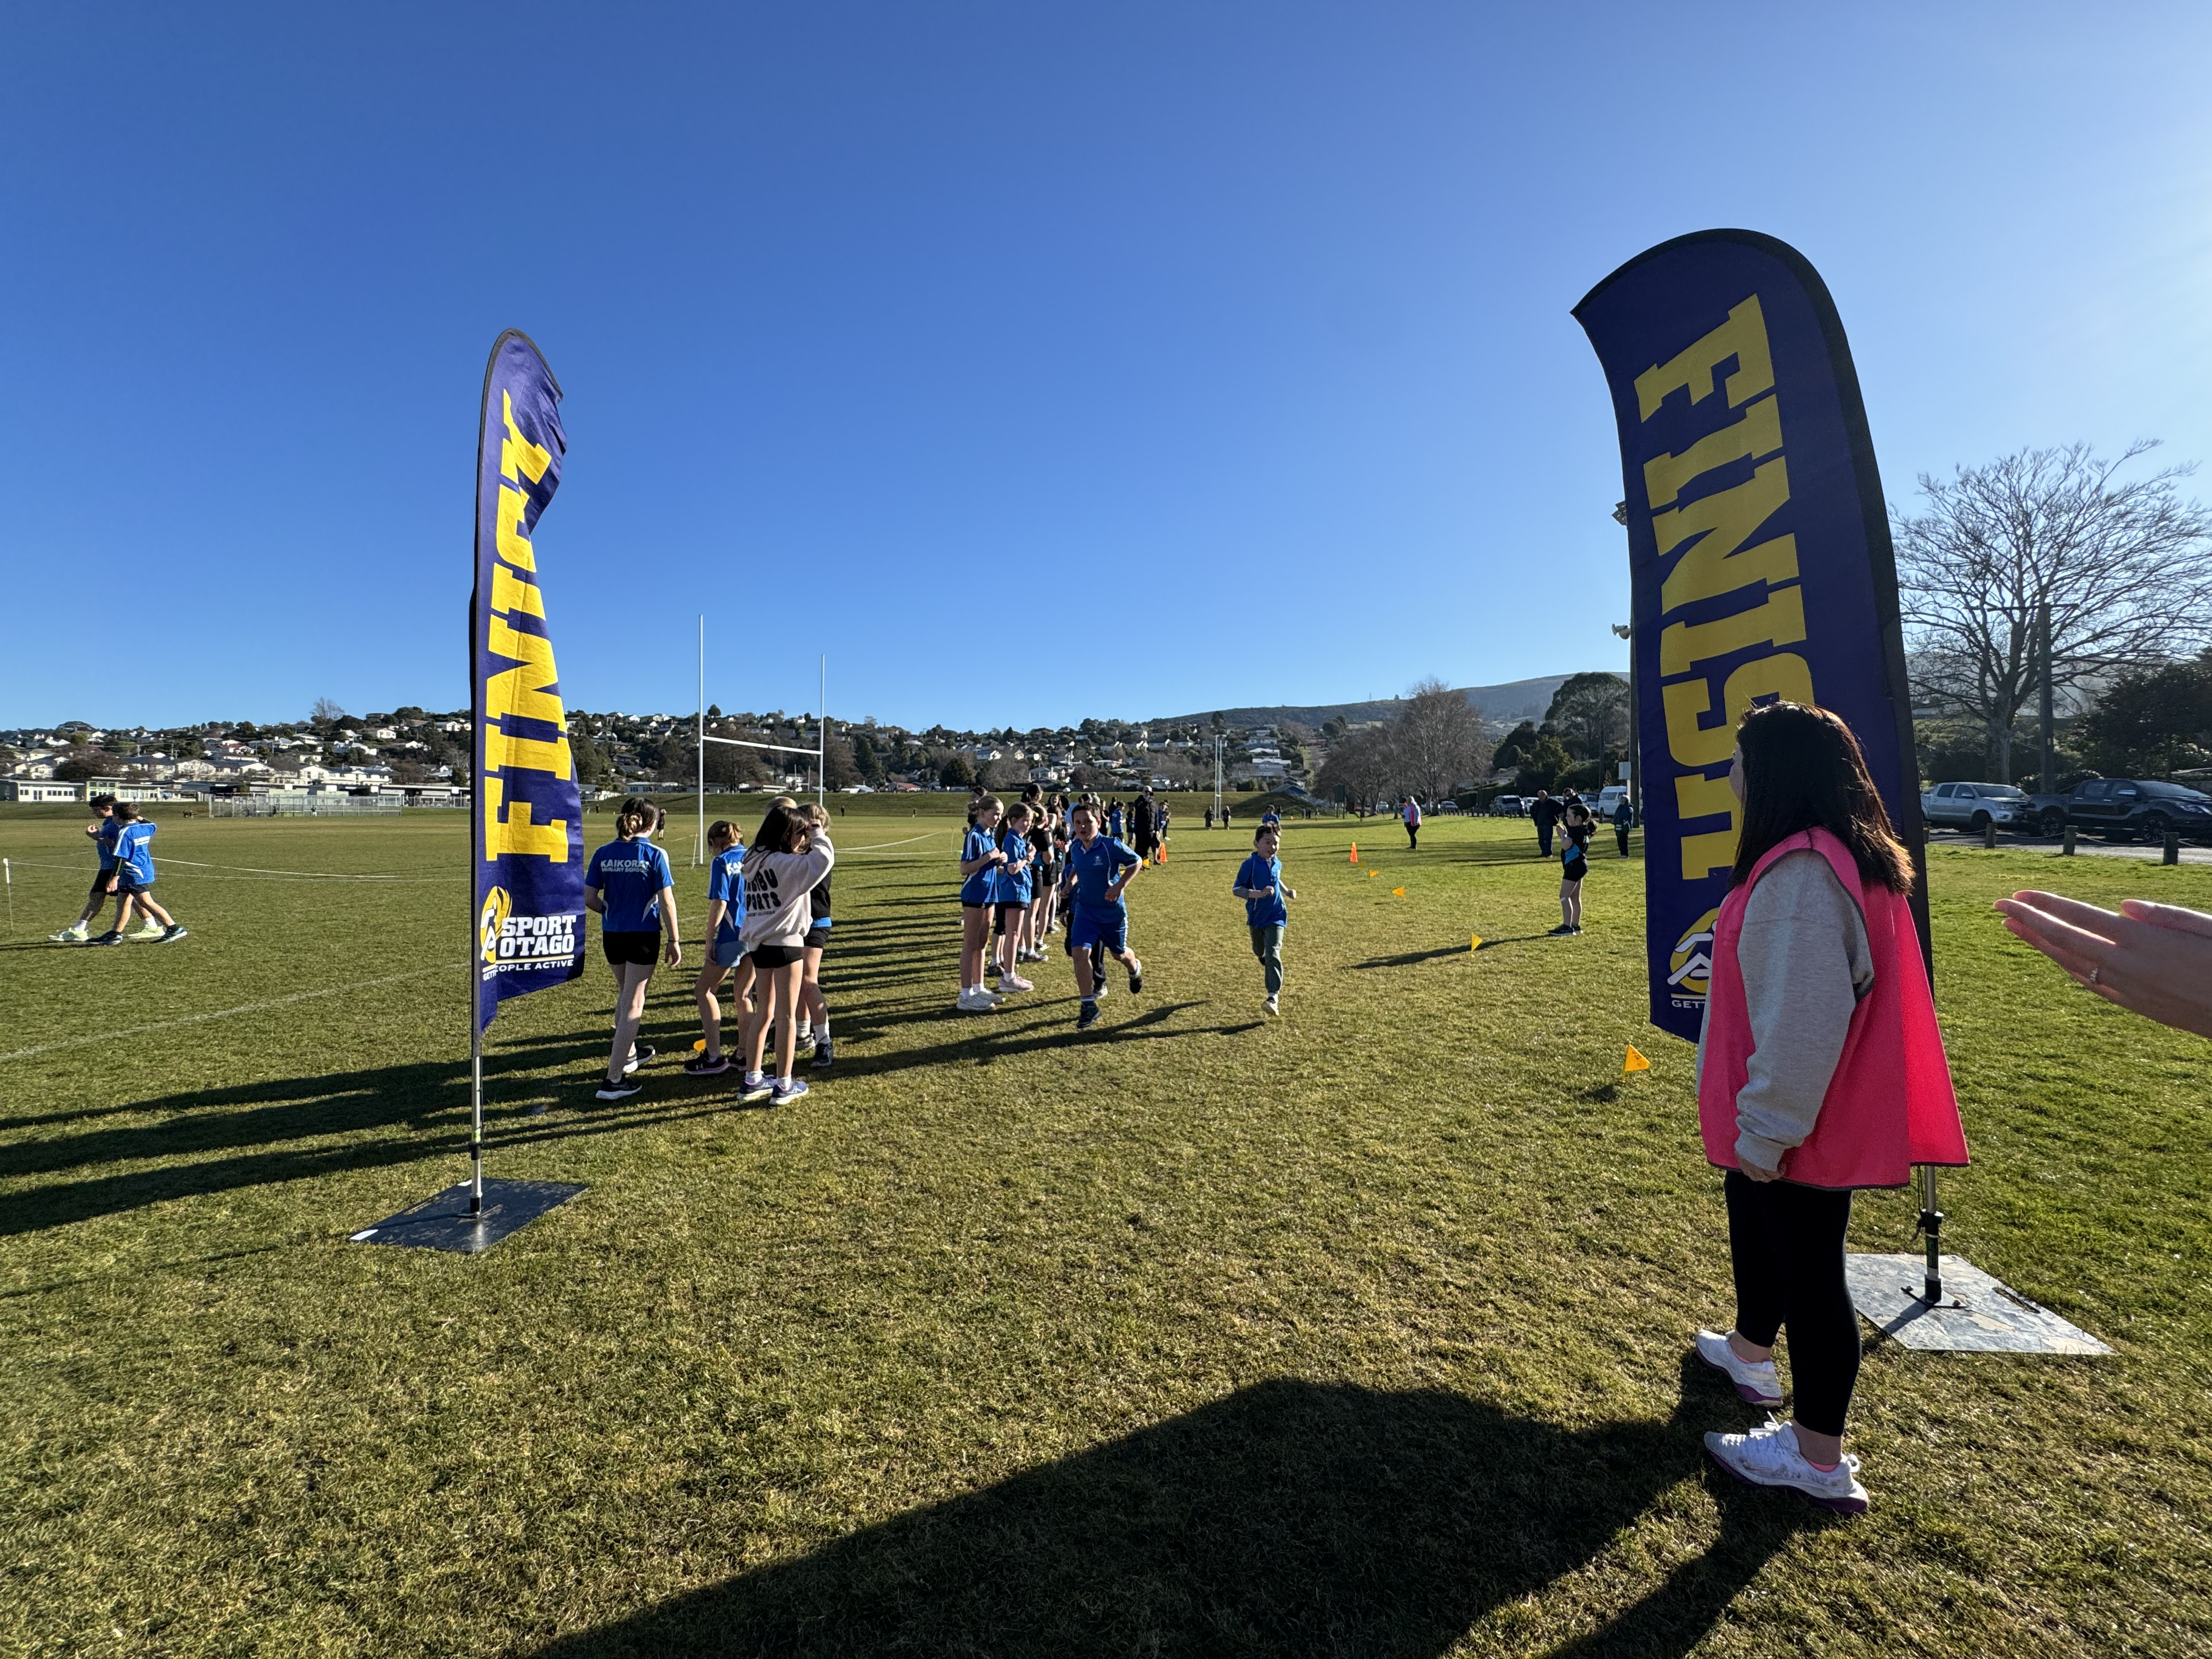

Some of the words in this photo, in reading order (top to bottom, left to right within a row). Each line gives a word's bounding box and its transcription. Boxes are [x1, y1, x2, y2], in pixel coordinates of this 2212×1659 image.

[747, 891, 781, 911] PORTS
[501, 915, 577, 937] SPORT
[500, 934, 575, 957] OTAGO
[534, 960, 574, 970] ACTIVE
